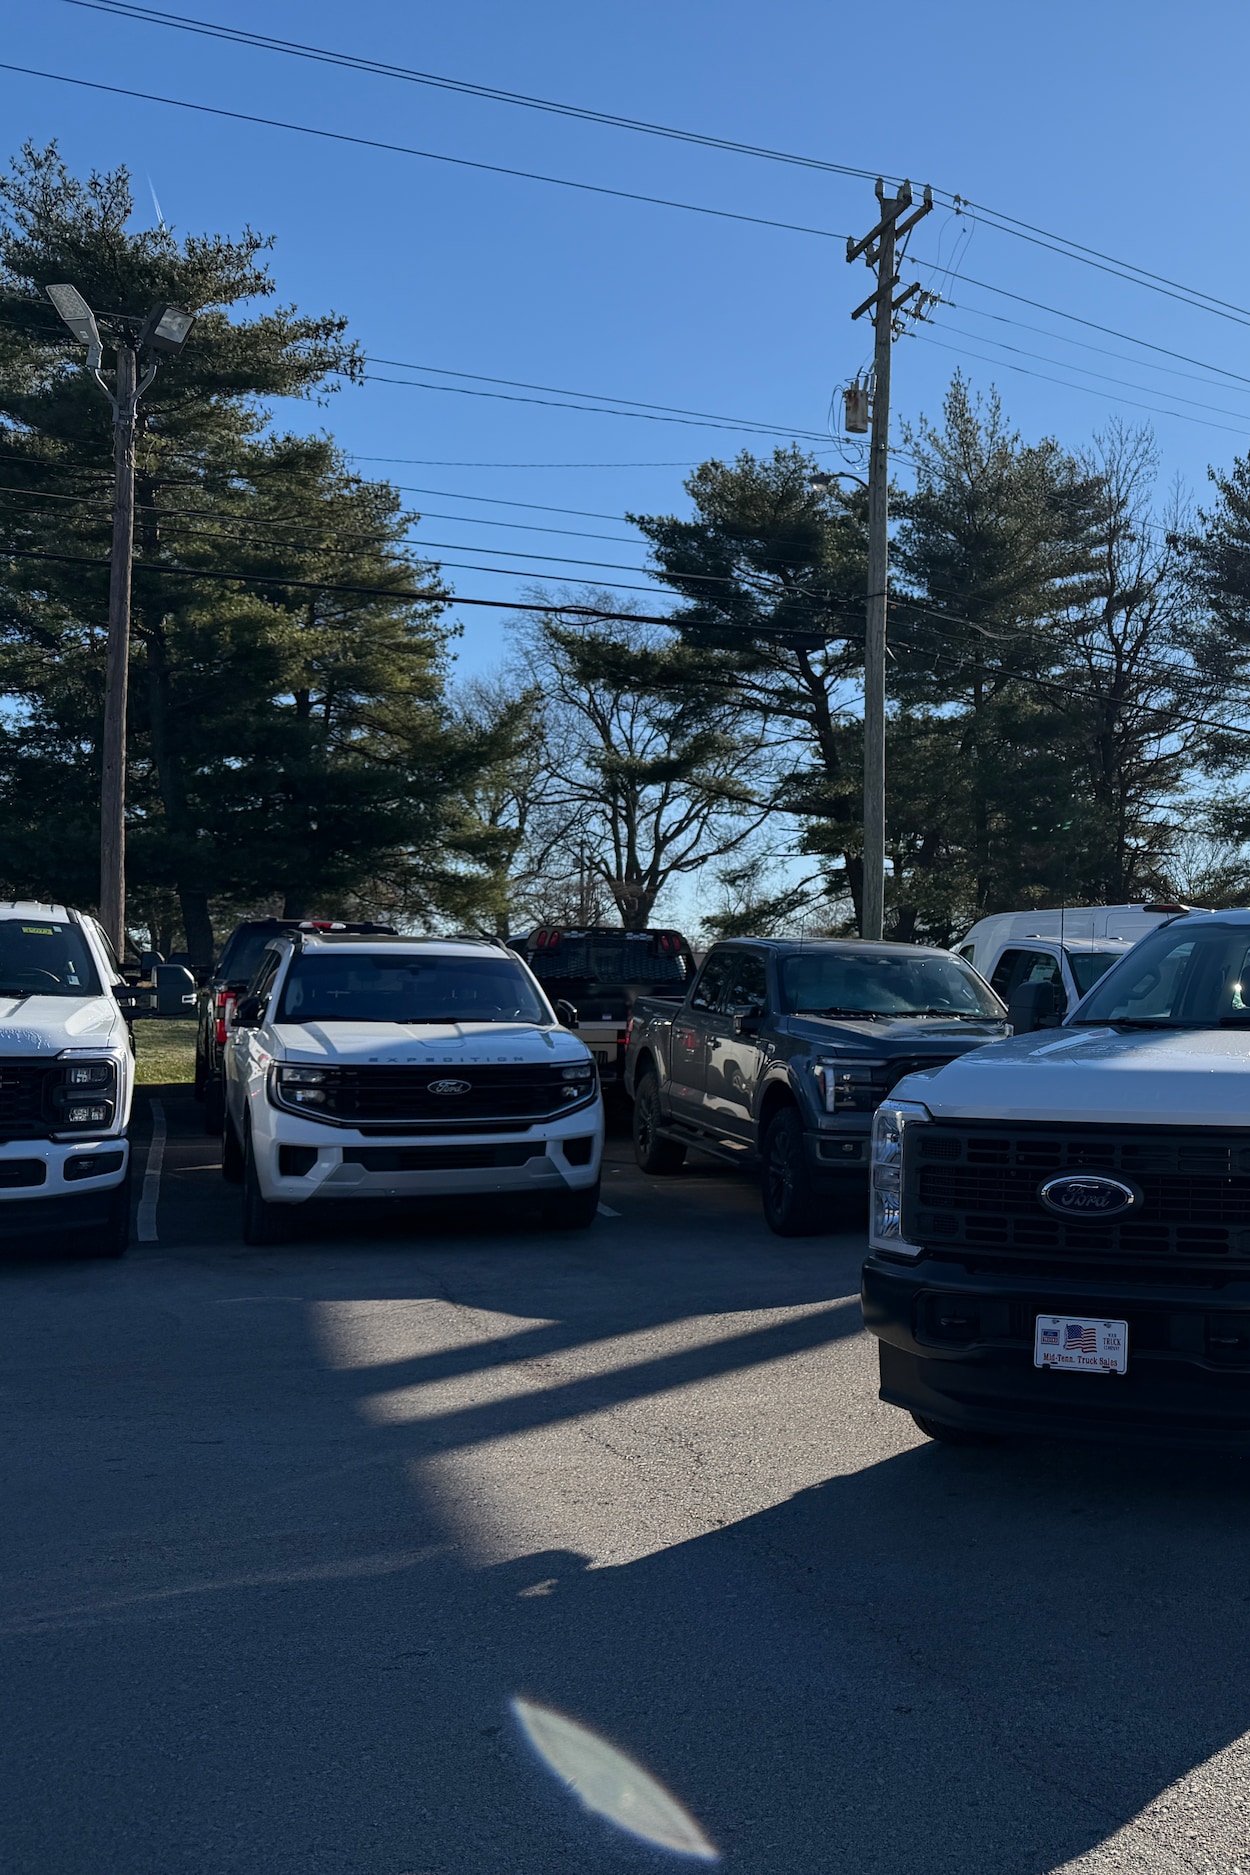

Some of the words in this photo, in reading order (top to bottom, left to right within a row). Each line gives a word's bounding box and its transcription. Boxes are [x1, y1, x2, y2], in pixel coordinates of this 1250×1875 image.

[435, 1081, 463, 1093] Ford
[1061, 1183, 1112, 1208] Ford
[1102, 1337, 1122, 1346] TRUCK
[1043, 1352, 1075, 1363] Mid-Tenn.
[1077, 1355, 1098, 1365] Truck
[1099, 1356, 1118, 1367] Sales
